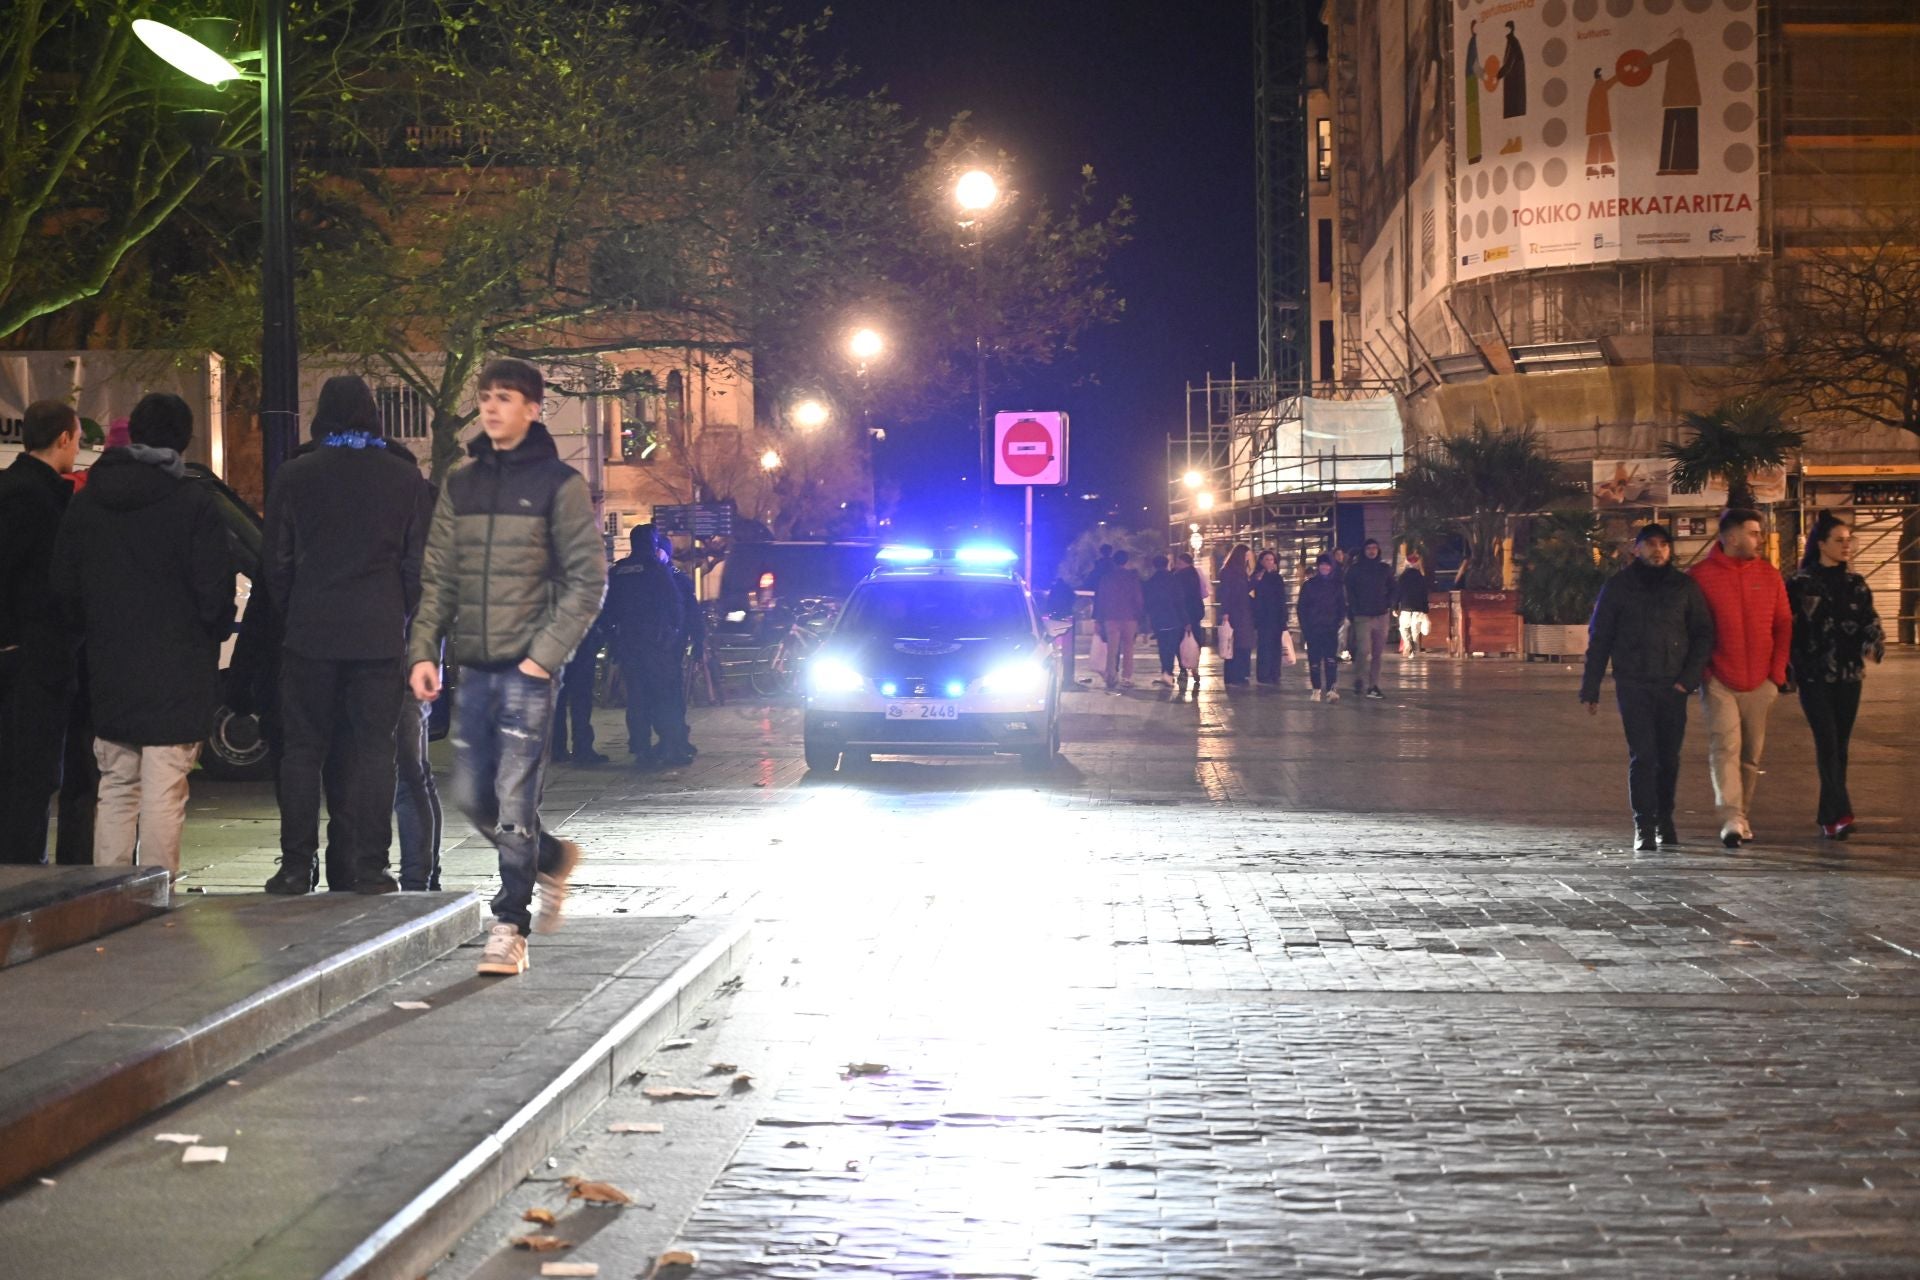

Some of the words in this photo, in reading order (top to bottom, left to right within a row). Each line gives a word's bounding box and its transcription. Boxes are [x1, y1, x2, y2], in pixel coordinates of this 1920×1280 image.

[1512, 203, 1582, 227] TOKIKO
[1587, 193, 1752, 220] MERKATARITZA
[920, 705, 955, 718] 2448
